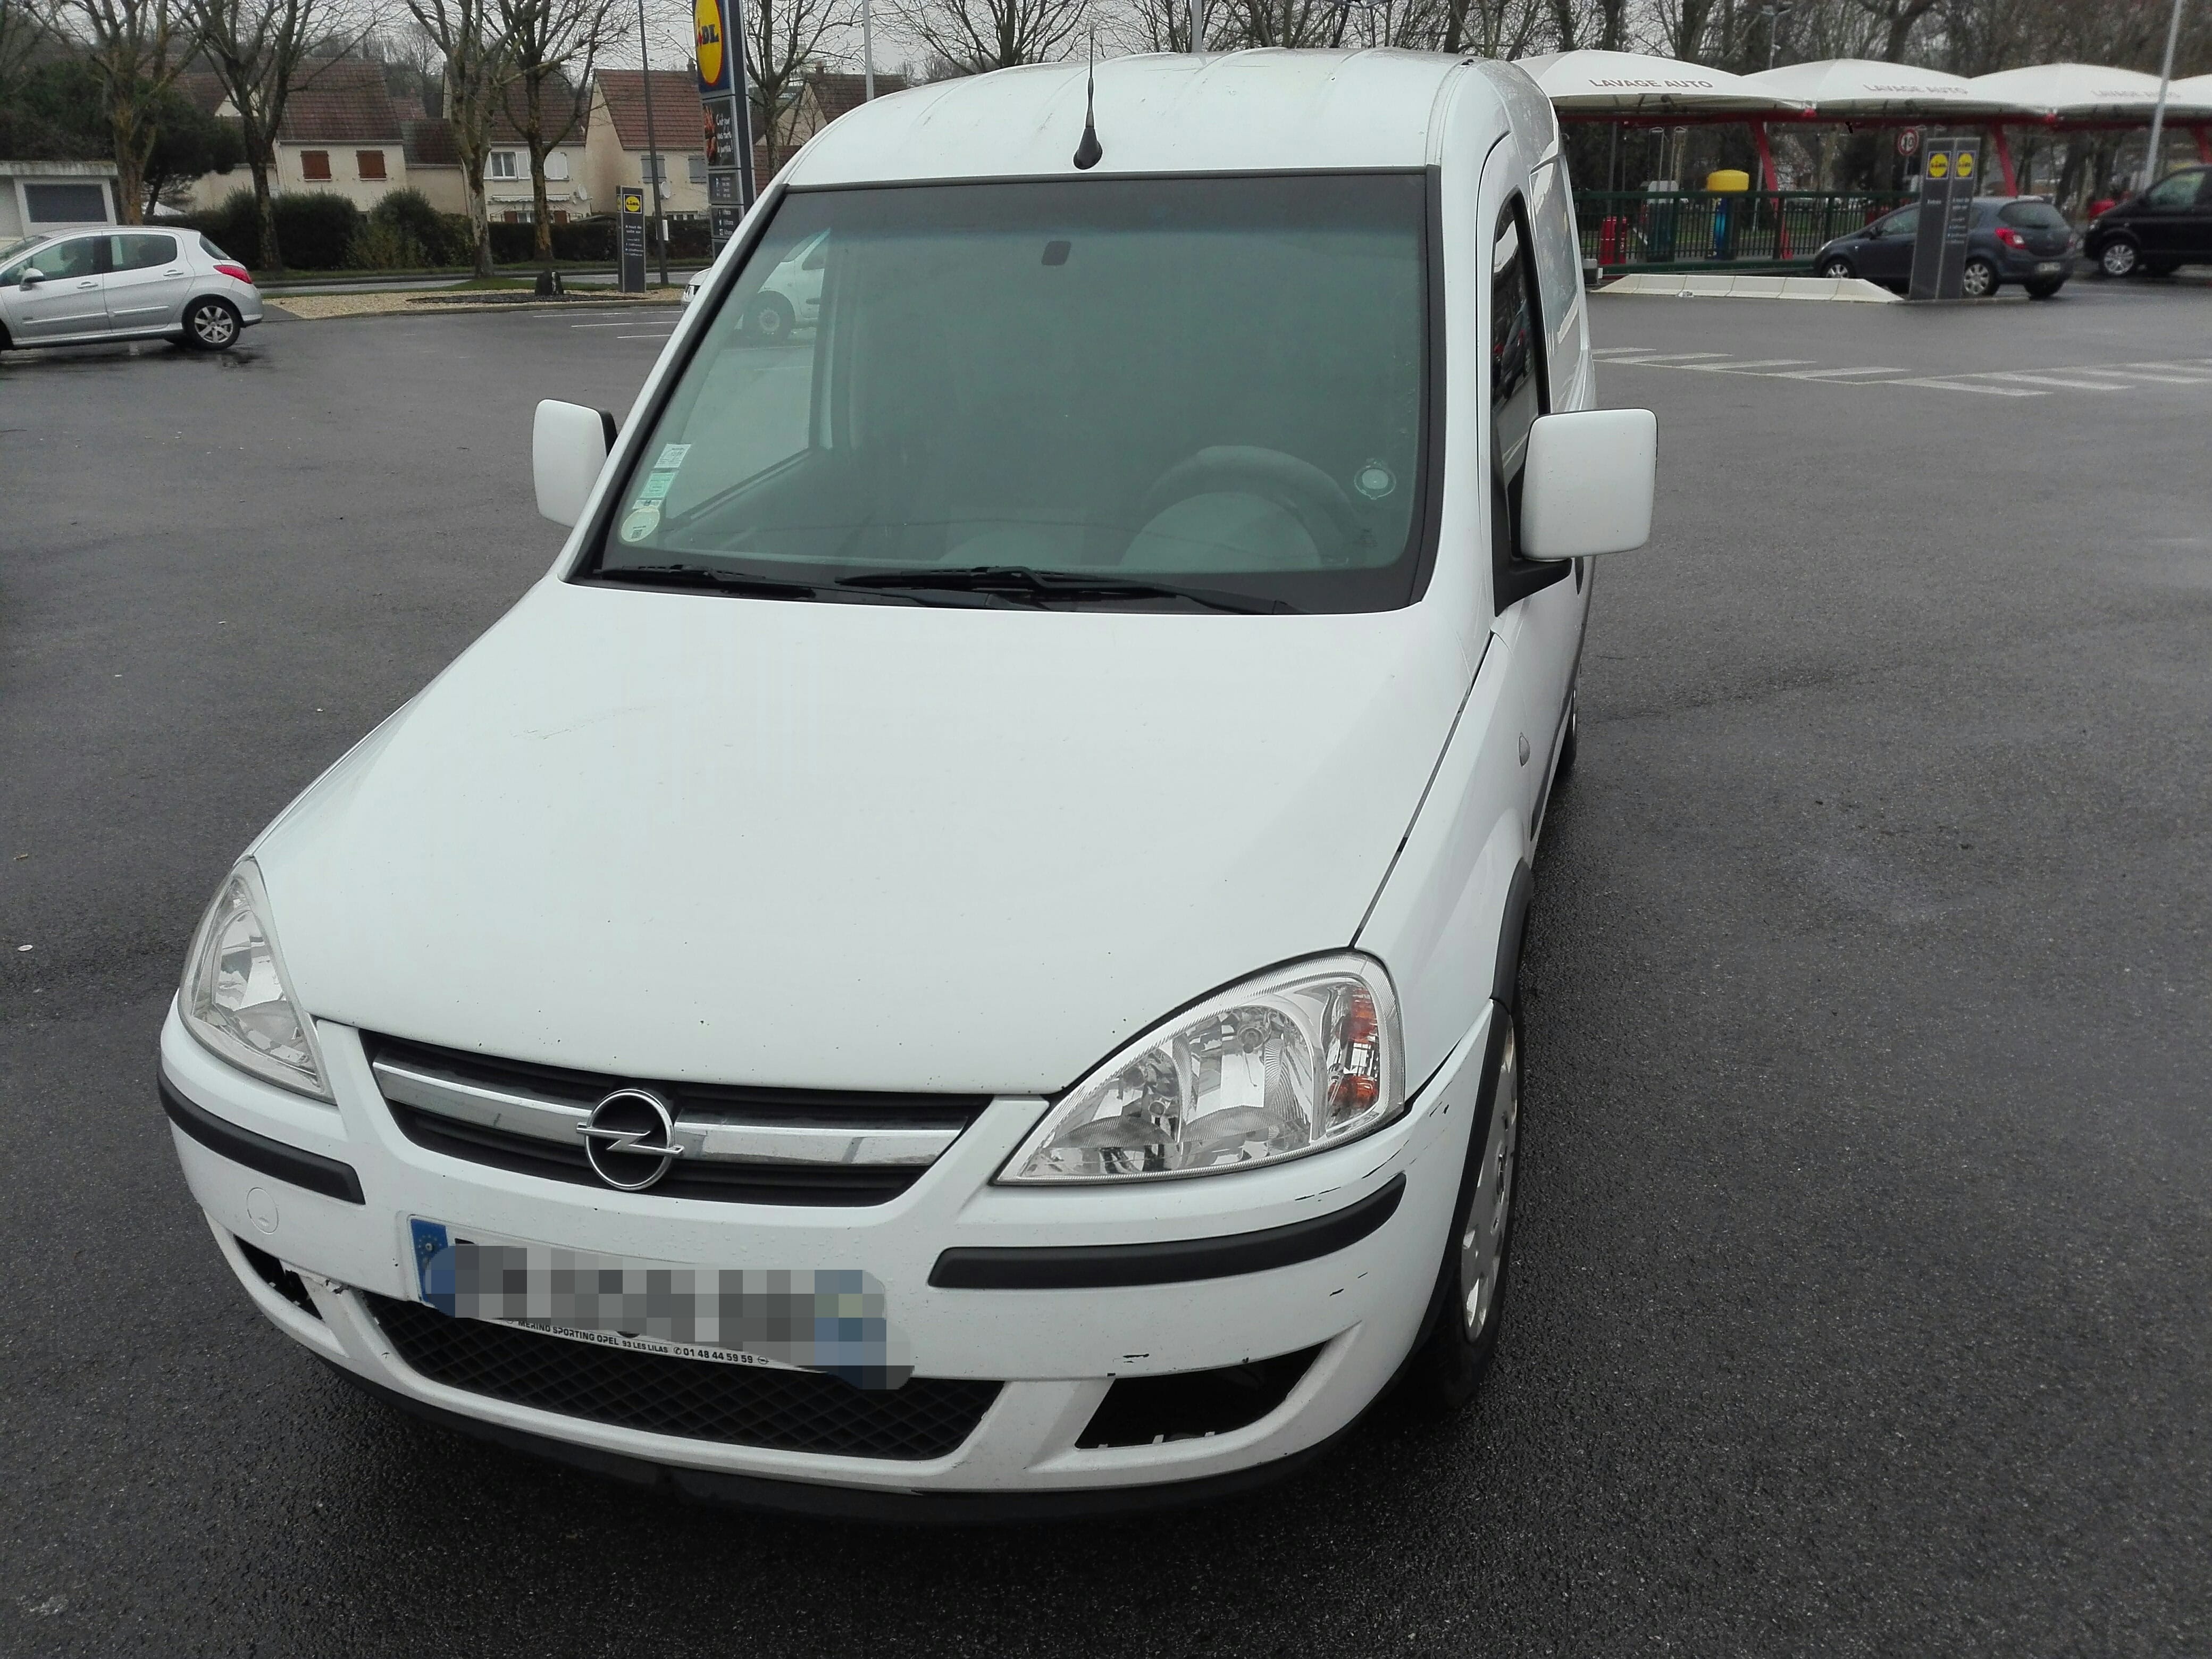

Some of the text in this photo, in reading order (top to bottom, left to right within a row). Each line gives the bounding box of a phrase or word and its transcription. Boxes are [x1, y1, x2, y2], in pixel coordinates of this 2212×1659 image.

[1904, 135, 1914, 149] 10
[518, 1320, 550, 1332] MERINO
[553, 1326, 594, 1342] SPORTING
[597, 1335, 618, 1345] OPEL
[648, 1344, 668, 1353] LILAS
[683, 1347, 694, 1356] 01
[698, 1350, 709, 1359] 48
[712, 1351, 724, 1360] 44
[726, 1353, 738, 1362] 59
[741, 1355, 753, 1364] 59
